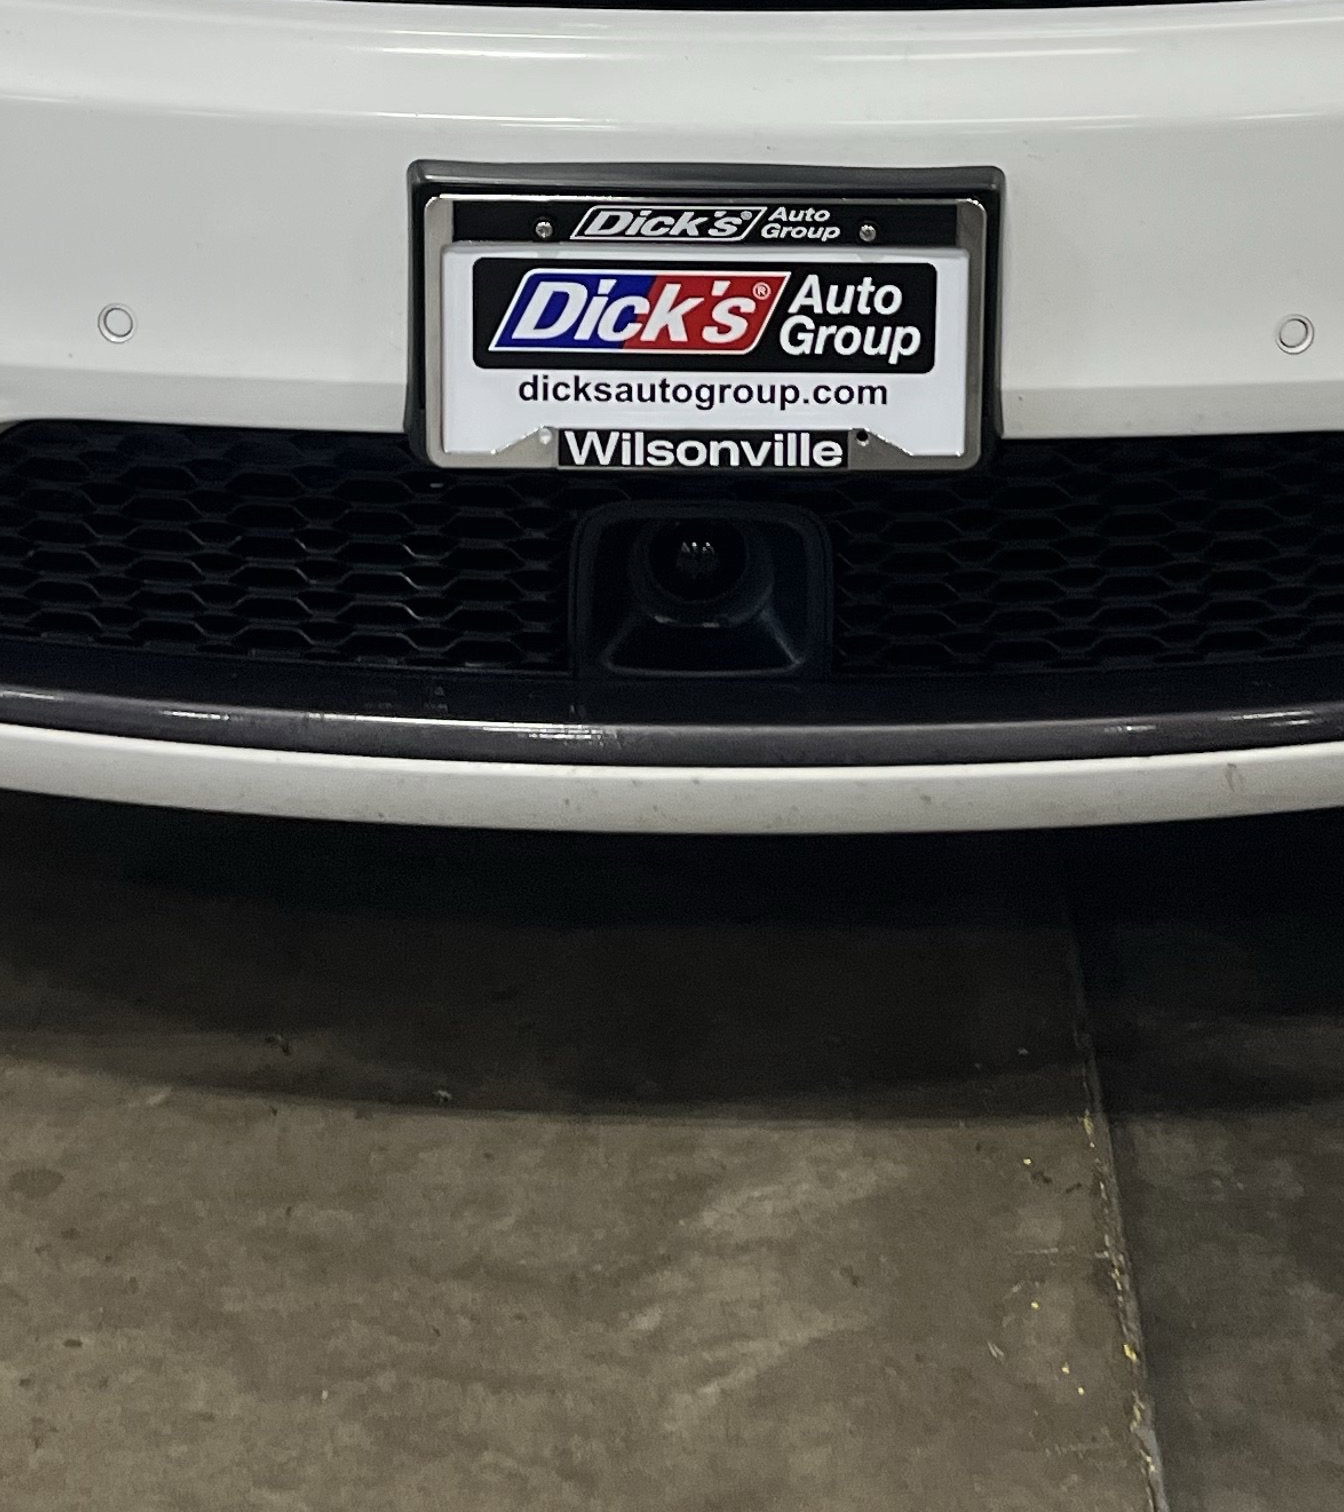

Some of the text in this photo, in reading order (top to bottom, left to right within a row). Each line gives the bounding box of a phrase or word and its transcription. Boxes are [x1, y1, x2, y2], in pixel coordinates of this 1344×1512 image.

[760, 223, 841, 242] Group
[767, 206, 831, 223] Auto
[787, 273, 904, 316] Auto
[778, 315, 922, 365] Group
[518, 374, 889, 411] dicksautogroup.com
[563, 429, 844, 469] Wilsonville
